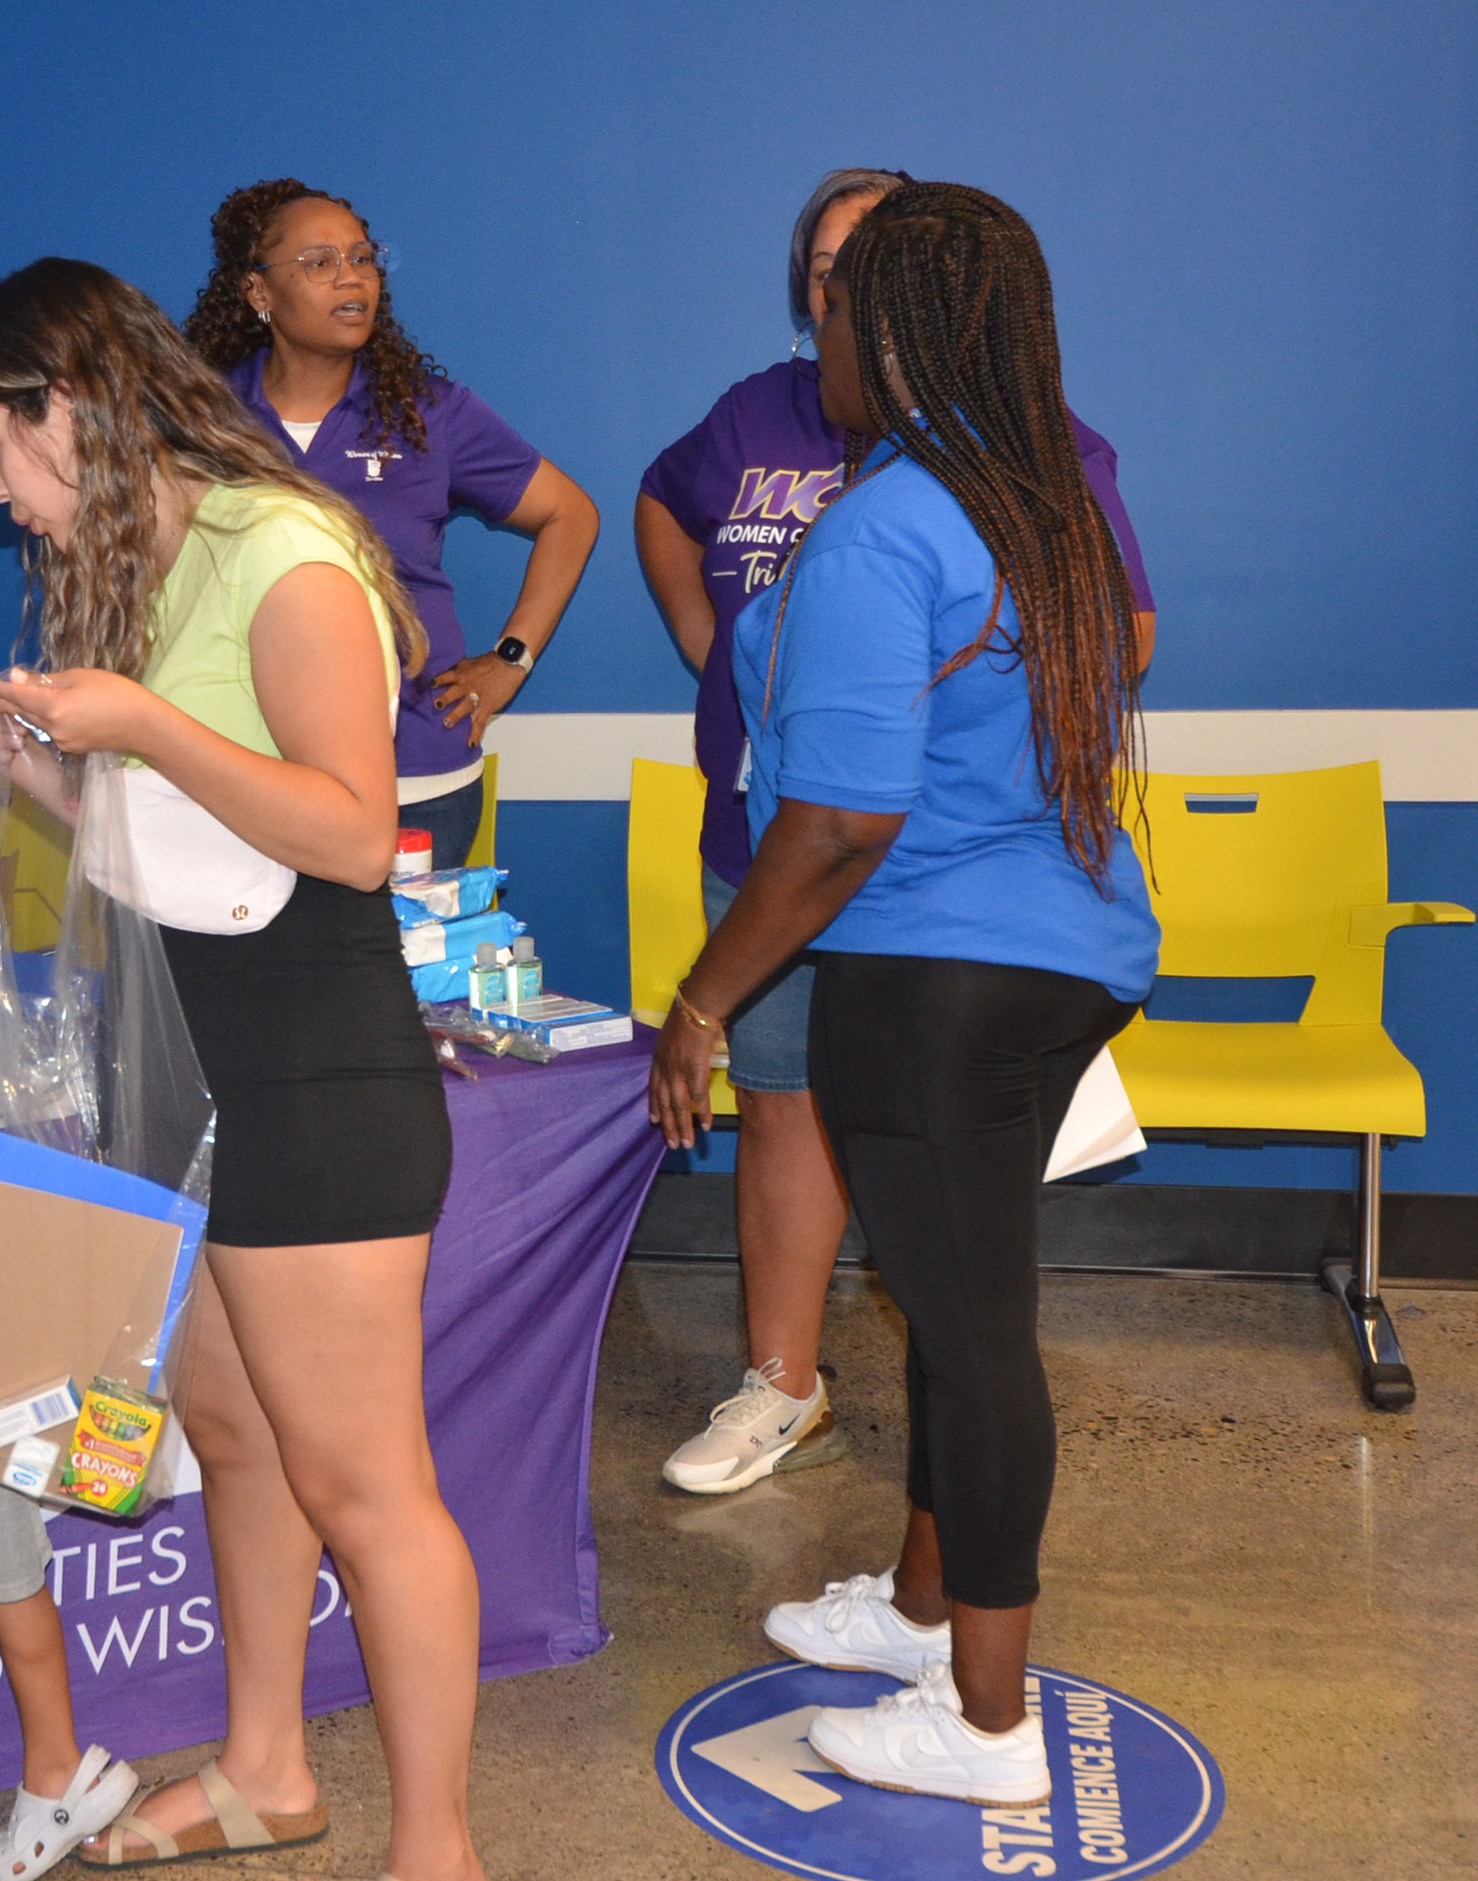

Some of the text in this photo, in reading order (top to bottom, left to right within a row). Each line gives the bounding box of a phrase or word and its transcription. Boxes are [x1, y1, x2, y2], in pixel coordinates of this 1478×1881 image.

[716, 524, 805, 545] WOMEN O
[95, 1400, 148, 1427] Crayola
[70, 1451, 140, 1490] CRAYONS
[1053, 1688, 1129, 1865] COMIENCE AQUÍ
